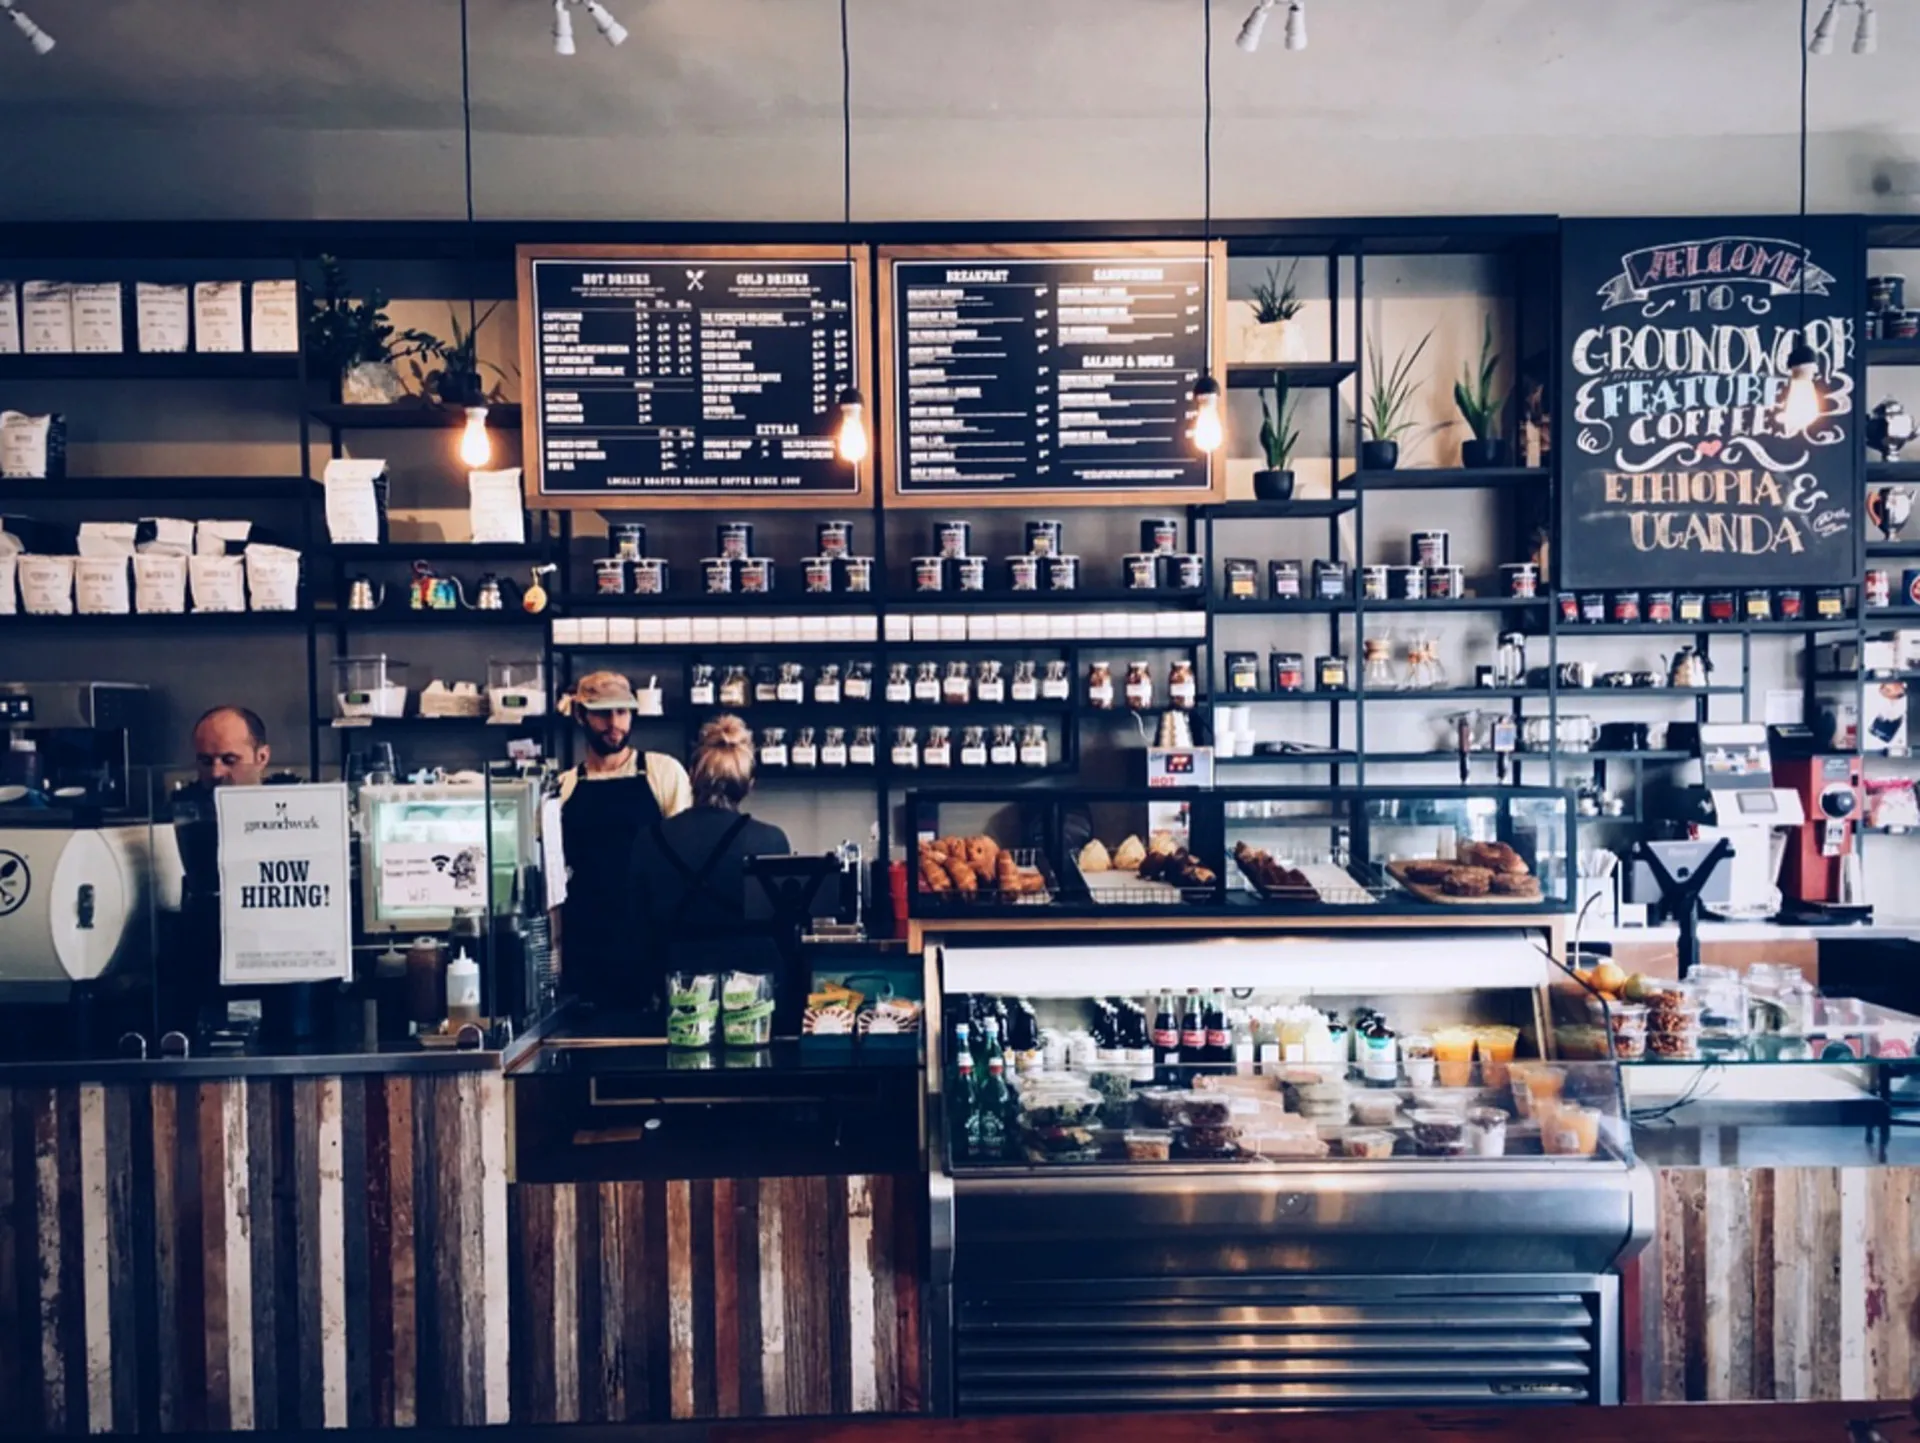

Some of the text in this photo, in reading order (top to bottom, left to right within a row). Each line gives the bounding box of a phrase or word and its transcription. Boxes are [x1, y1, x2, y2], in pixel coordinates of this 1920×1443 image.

[1628, 242, 1799, 286] WELCOME
[583, 273, 650, 285] HOT DRINKS
[736, 273, 809, 285] COLD DRINKS
[946, 270, 1009, 283] BREAKFAST
[1682, 285, 1734, 312] TO
[756, 424, 799, 435] EXTRAS
[1604, 469, 1829, 513] ETHIOPIA &
[1628, 512, 1806, 555] UGANDA
[244, 816, 319, 834] groundwork
[259, 860, 310, 884] NOW
[241, 885, 330, 908] HIRING!
